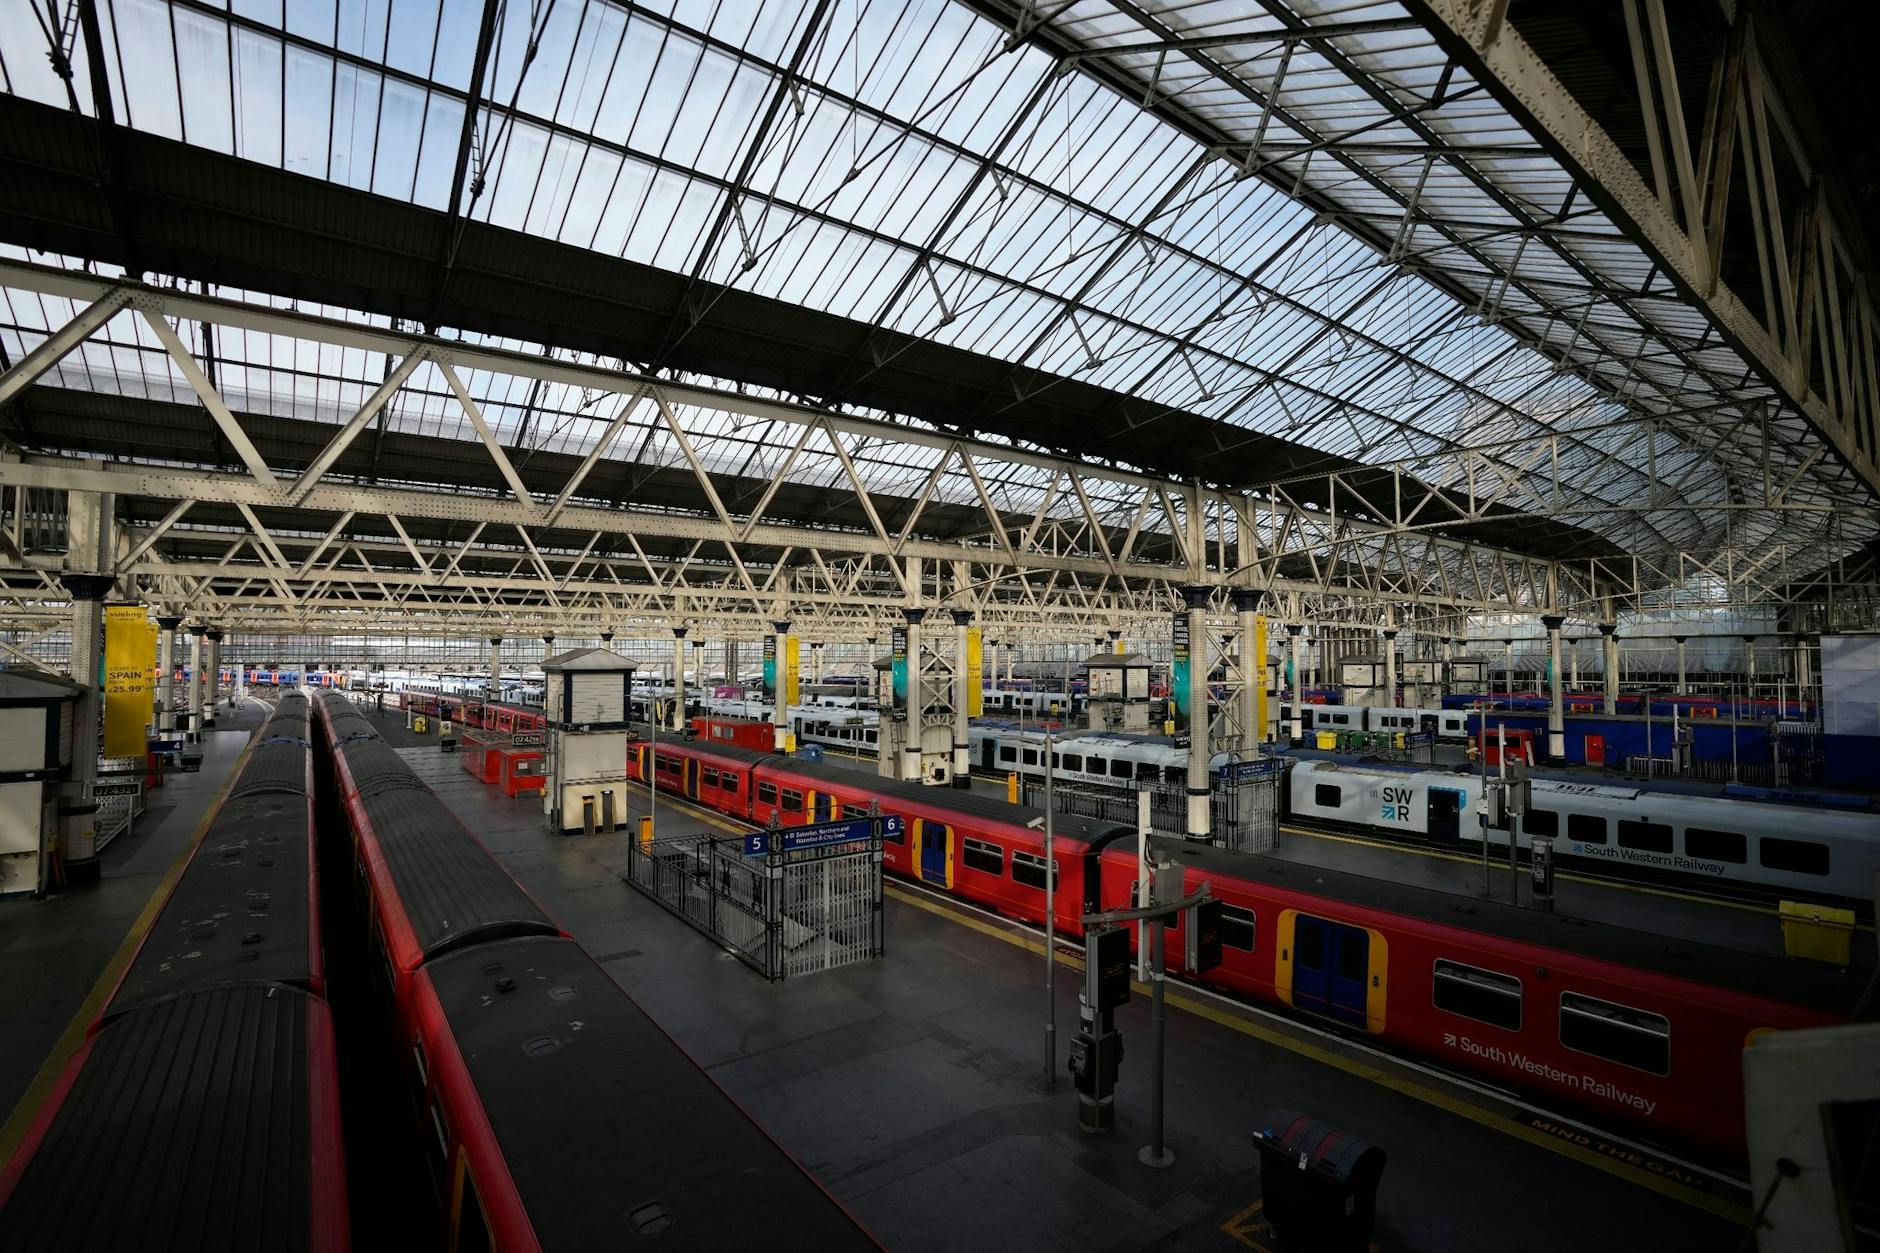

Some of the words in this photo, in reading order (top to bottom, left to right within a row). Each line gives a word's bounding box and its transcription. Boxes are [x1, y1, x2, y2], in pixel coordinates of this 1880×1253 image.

[109, 671, 142, 679] SPAIN
[173, 742, 180, 750] 4
[1382, 787, 1413, 805] SW
[1397, 805, 1409, 822] R
[887, 818, 896, 831] 6
[752, 837, 761, 850] 5
[1584, 844, 1619, 859] South
[1620, 848, 1672, 867] Western
[1674, 856, 1725, 876] Railway
[1460, 1036, 1506, 1064] South
[1507, 1051, 1580, 1089] Western
[1582, 1075, 1656, 1115] Railway
[1531, 1118, 1591, 1147] MIND
[1597, 1142, 1643, 1164] THE
